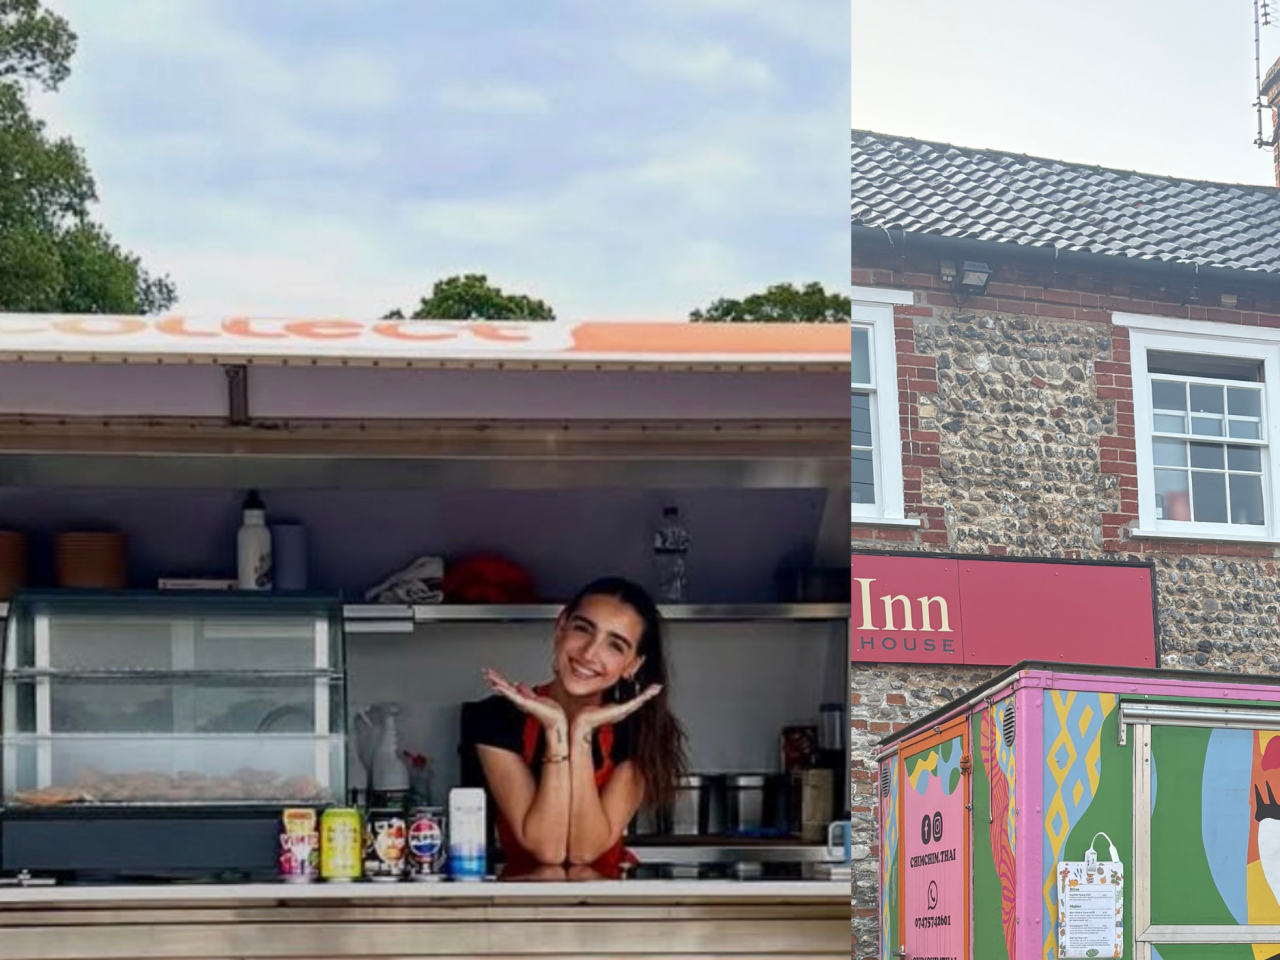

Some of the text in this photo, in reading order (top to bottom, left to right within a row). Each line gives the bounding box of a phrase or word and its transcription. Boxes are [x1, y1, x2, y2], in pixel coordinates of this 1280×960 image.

[853, 577, 954, 632] Inn
[860, 636, 956, 652] HOUSE
[910, 848, 956, 868] CHIMCHIM.THAI
